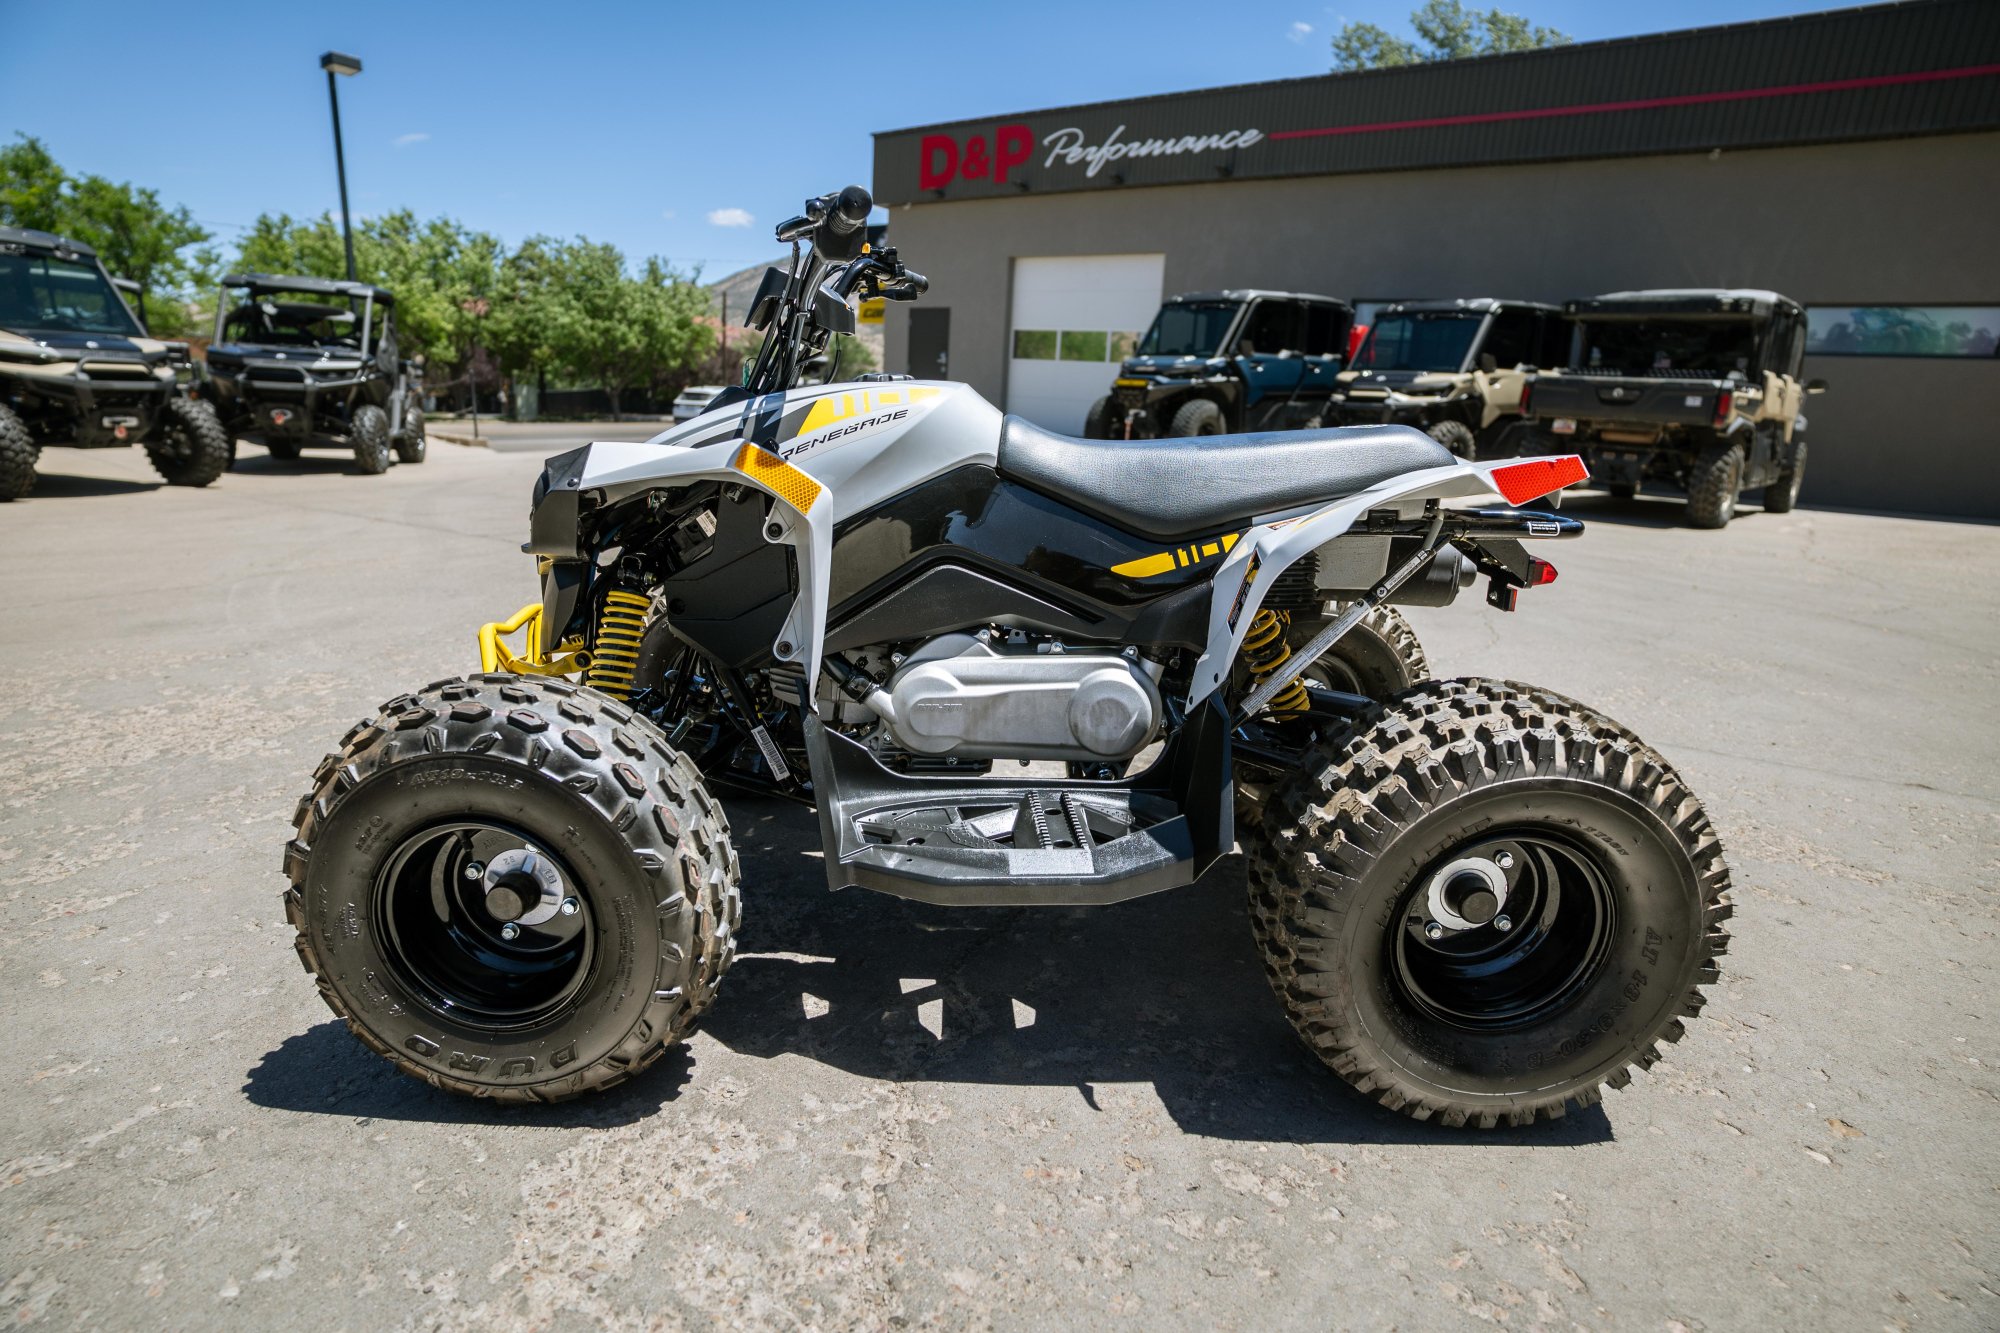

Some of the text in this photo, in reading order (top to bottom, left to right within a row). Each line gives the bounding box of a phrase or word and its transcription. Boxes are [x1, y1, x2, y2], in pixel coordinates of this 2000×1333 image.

[918, 124, 1265, 191] D&P Performance
[780, 409, 909, 460] RENEGADE
[403, 1033, 579, 1079] DURO
